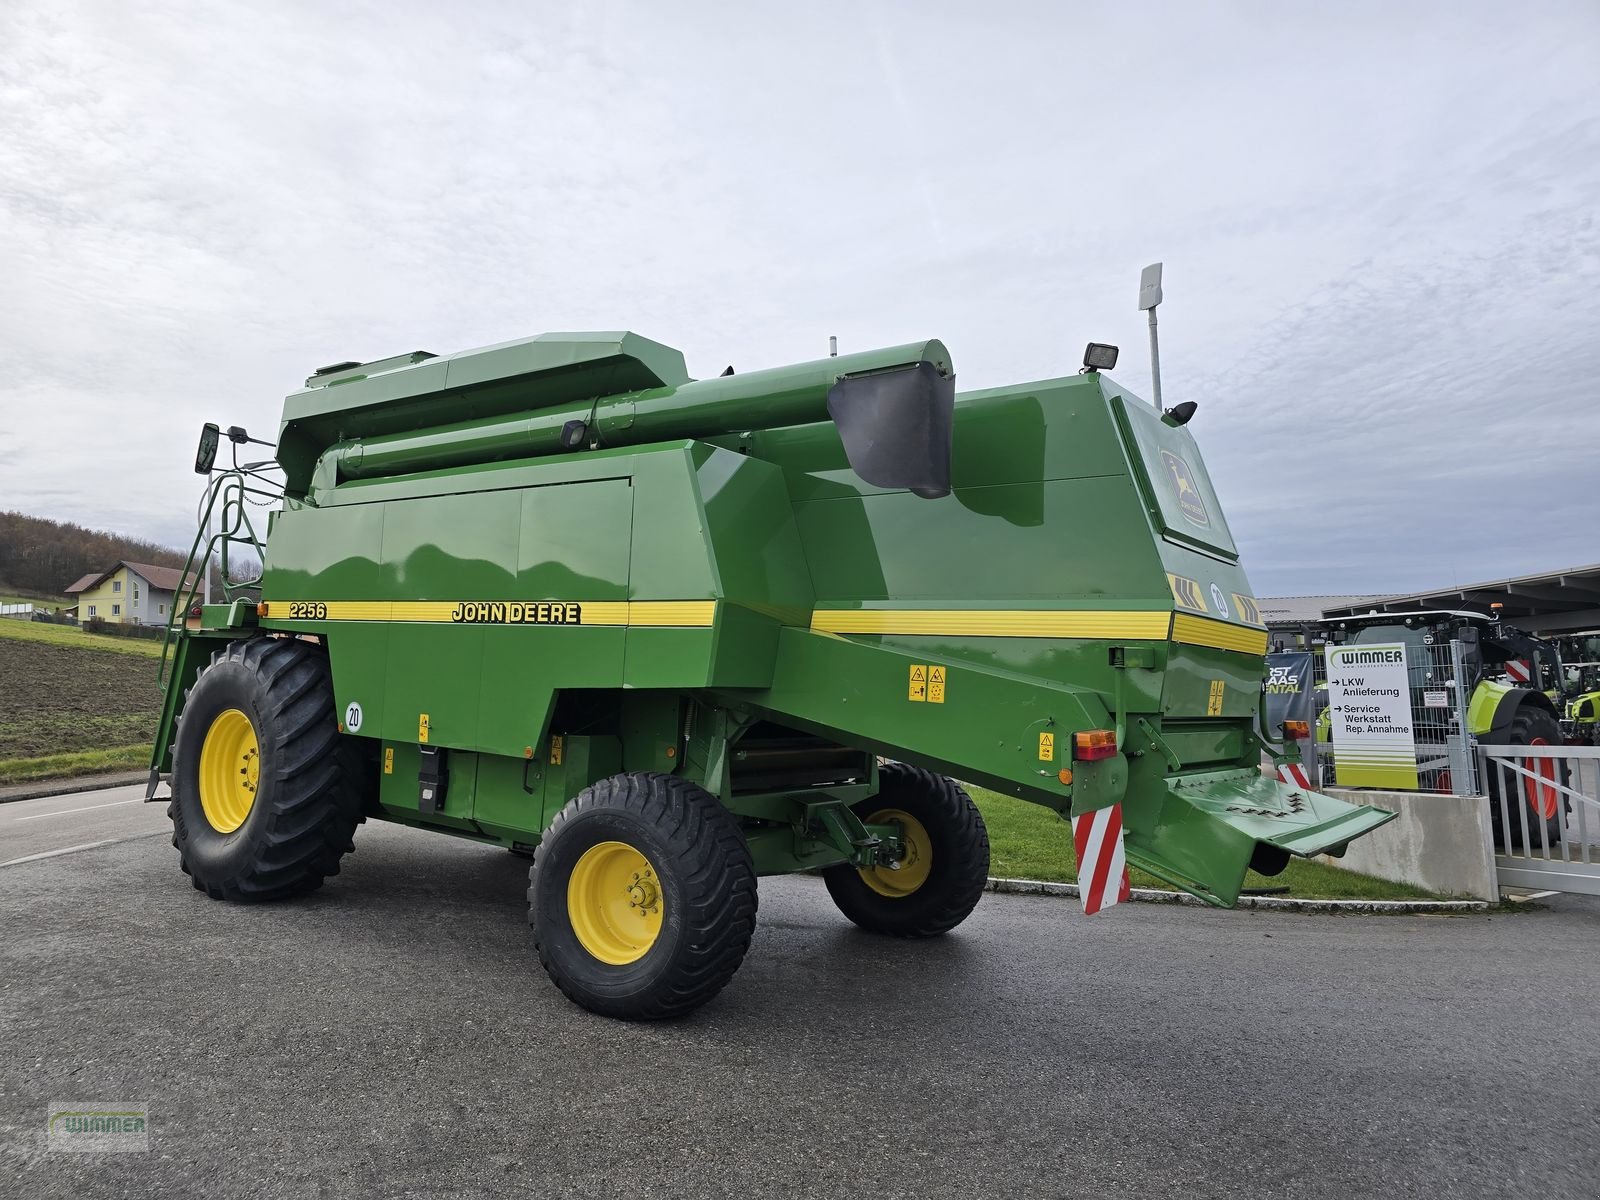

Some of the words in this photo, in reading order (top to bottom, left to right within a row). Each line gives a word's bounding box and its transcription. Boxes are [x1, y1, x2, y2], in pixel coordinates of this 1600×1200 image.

[289, 602, 327, 619] 2256
[452, 602, 506, 623] JOHN
[510, 602, 581, 624] DEERE
[1341, 651, 1403, 664] WIMMER
[1265, 675, 1299, 685] AAS
[1341, 678, 1364, 687] LKW
[1342, 688, 1400, 697] Anlieferung
[1343, 705, 1380, 713] Service
[349, 707, 360, 727] 20
[1344, 714, 1392, 723] Werkstatt
[1345, 724, 1365, 734] Rep.
[1367, 725, 1409, 734] Annahme
